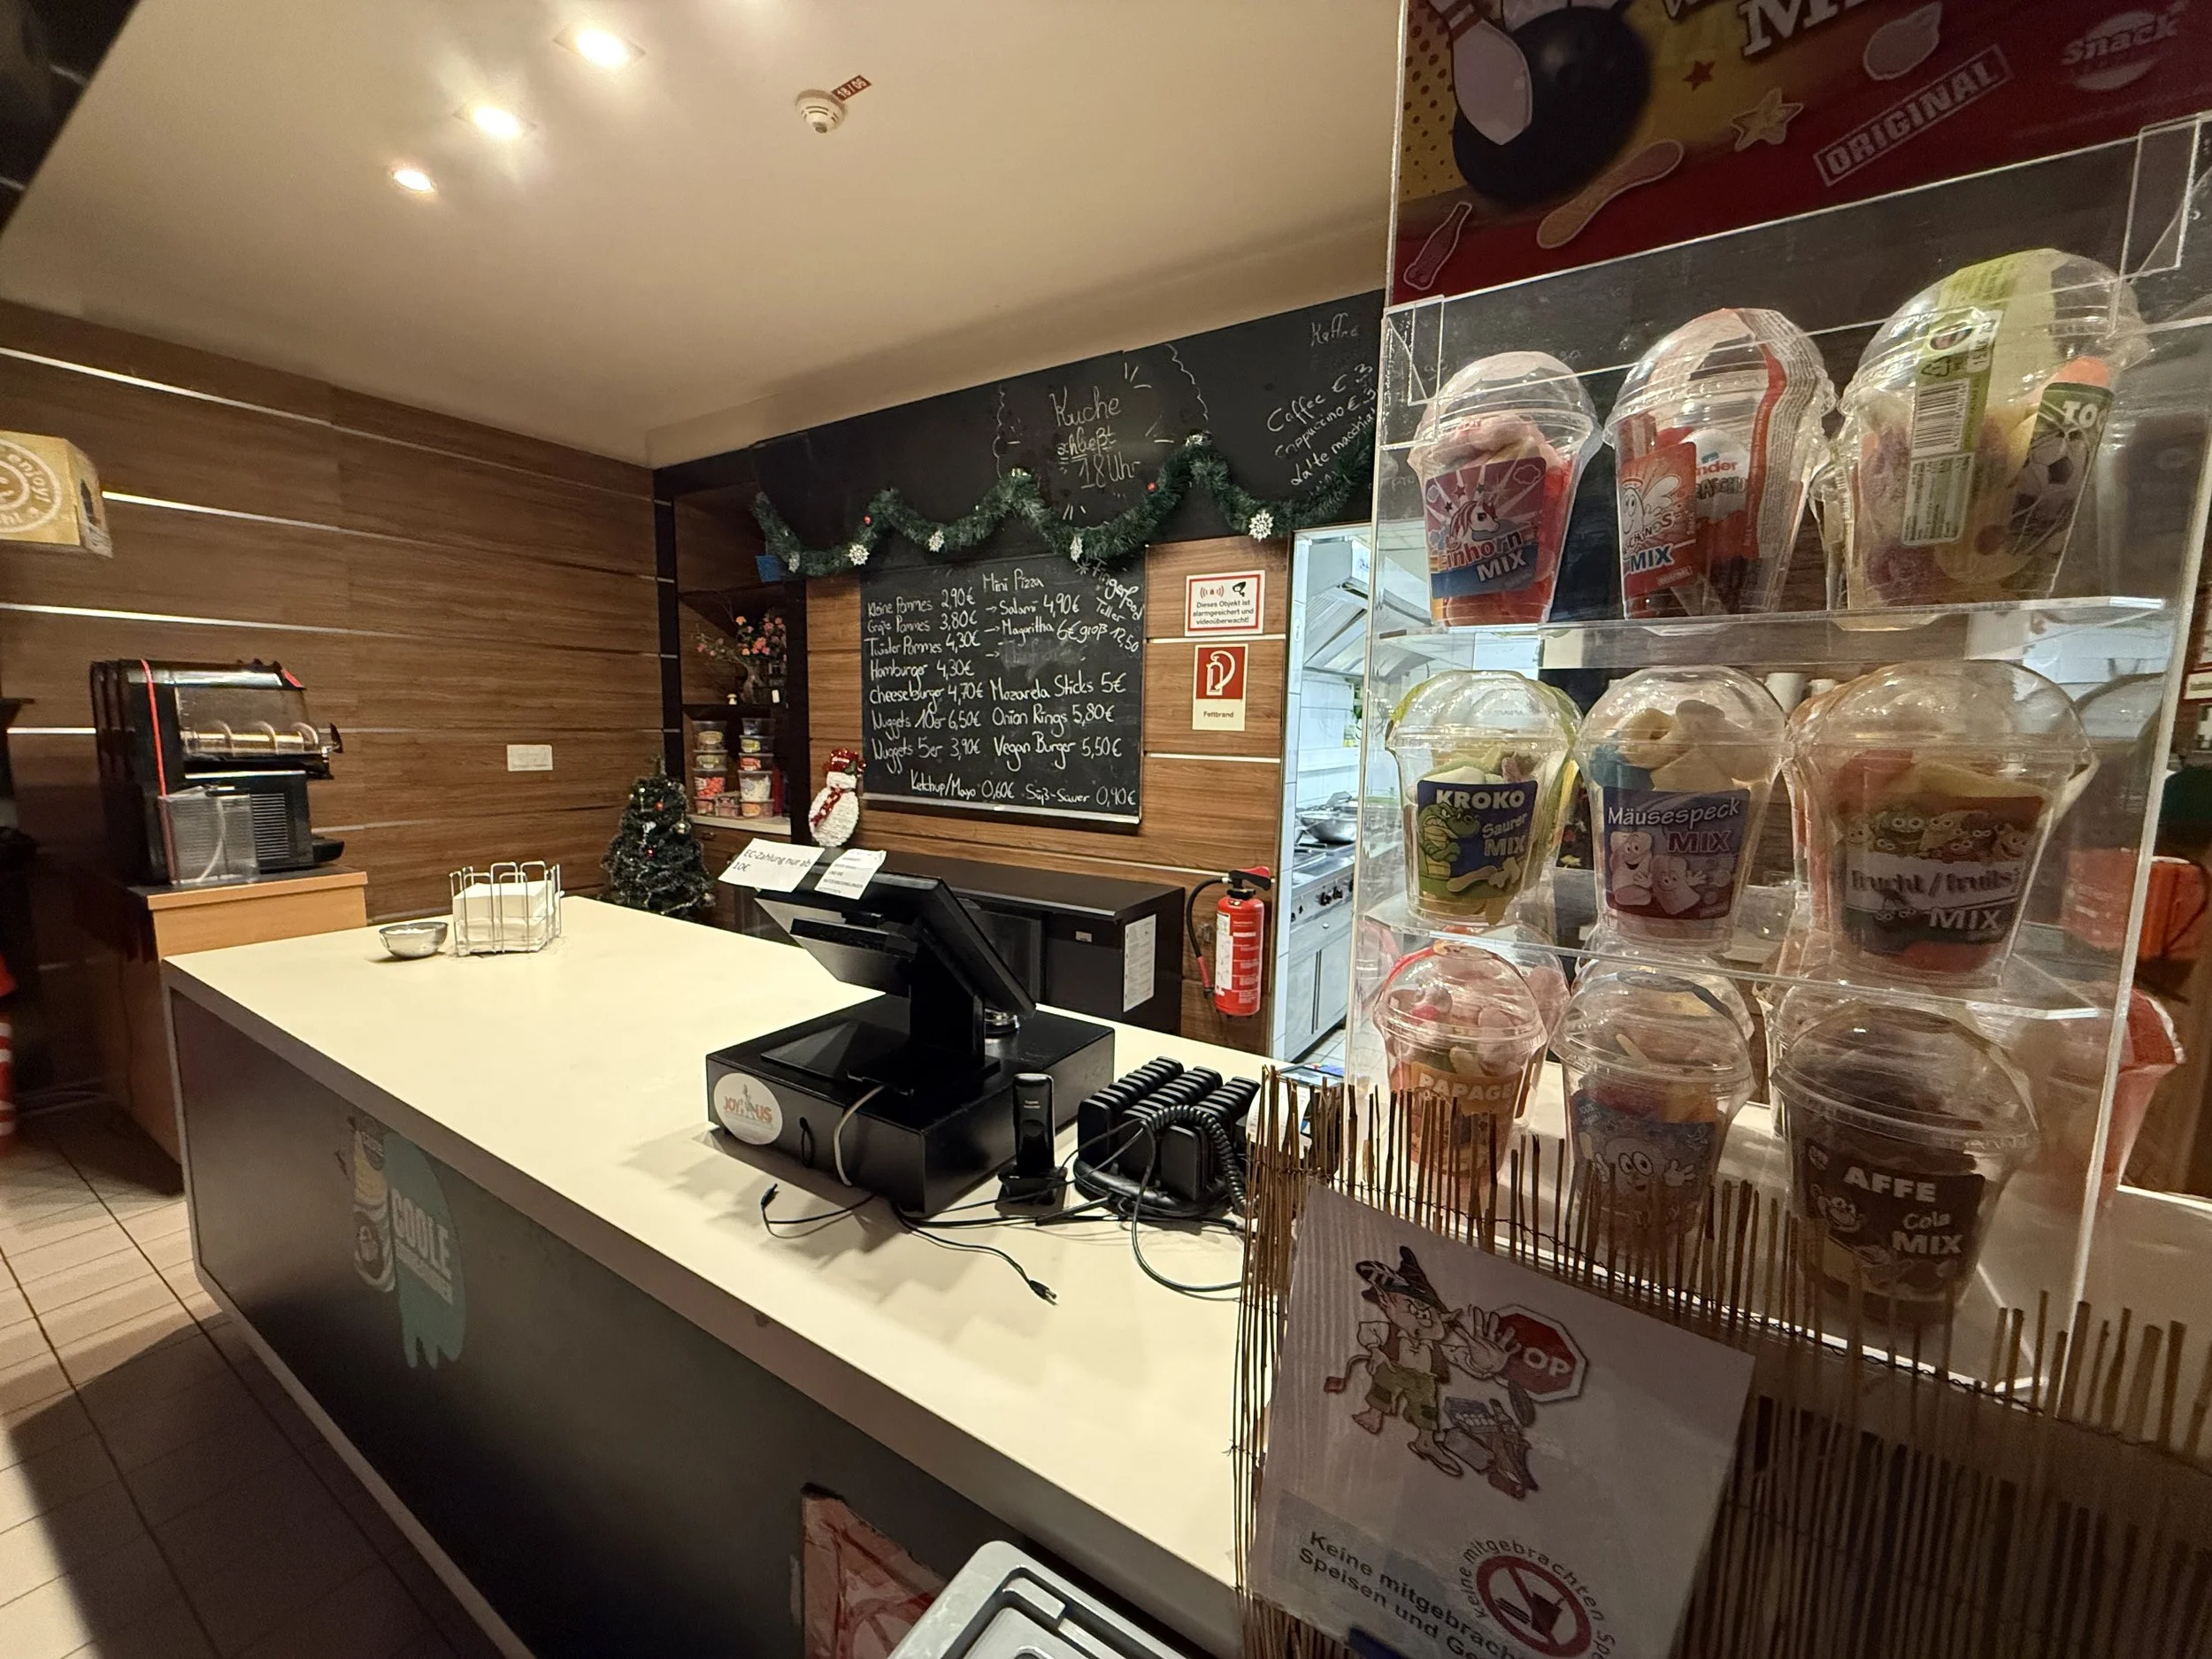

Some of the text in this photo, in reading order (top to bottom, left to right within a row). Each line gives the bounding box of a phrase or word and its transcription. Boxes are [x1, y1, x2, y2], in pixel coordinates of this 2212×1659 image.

[1826, 61, 1999, 176] ORIGINAL
[1076, 451, 1141, 488] 18 Uhr
[1477, 549, 1526, 582] MIX
[1630, 545, 1672, 572] MIX
[982, 568, 1045, 593] Mini Pizza
[896, 596, 933, 613] Pommes
[941, 587, 976, 611] 2,90€
[999, 593, 1080, 618] Salami 4,90€
[1096, 596, 1126, 622] Teller
[1193, 608, 1240, 618] alarmgesichert
[1218, 600, 1240, 610] Objekt
[896, 615, 930, 633] Pommes
[940, 610, 978, 631] 3,80€
[1056, 619, 1081, 641] 6€
[903, 635, 942, 655] Pommes
[945, 630, 981, 654] 4,30€
[1110, 626, 1140, 653] 12,50
[937, 658, 975, 680] 4,30€
[948, 682, 984, 705] 4,70€
[1055, 670, 1094, 697] Sticks
[1101, 672, 1126, 693] 5€
[872, 709, 911, 741] Nuggets
[949, 710, 982, 730] 6,50€
[992, 703, 1115, 738] Onion Rings 5,80€
[1203, 710, 1234, 718] Fettbrand
[872, 736, 913, 774] Nuggets
[950, 738, 981, 761] 3,90€
[994, 731, 1122, 772] Vegan Burger 5,50€
[981, 780, 1016, 800] 0,60€
[1095, 786, 1137, 807] 0,90€
[1436, 788, 1525, 810] KROKO
[1481, 812, 1528, 839] Saurer
[1608, 796, 1740, 830] Mäusespeck
[1484, 834, 1527, 857] MIX
[1667, 829, 1732, 854] MIX
[786, 857, 799, 866] nur
[799, 858, 811, 867] ab
[1928, 907, 2001, 930] MIX
[1843, 1166, 1937, 1203] AFFE
[1903, 1211, 1951, 1230] Cola
[1892, 1231, 1963, 1256] MIX
[1522, 1347, 1572, 1377] OP
[1310, 1531, 1372, 1577] Keine
[1299, 1548, 1386, 1609] Speisen
[1394, 1607, 1440, 1639] und
